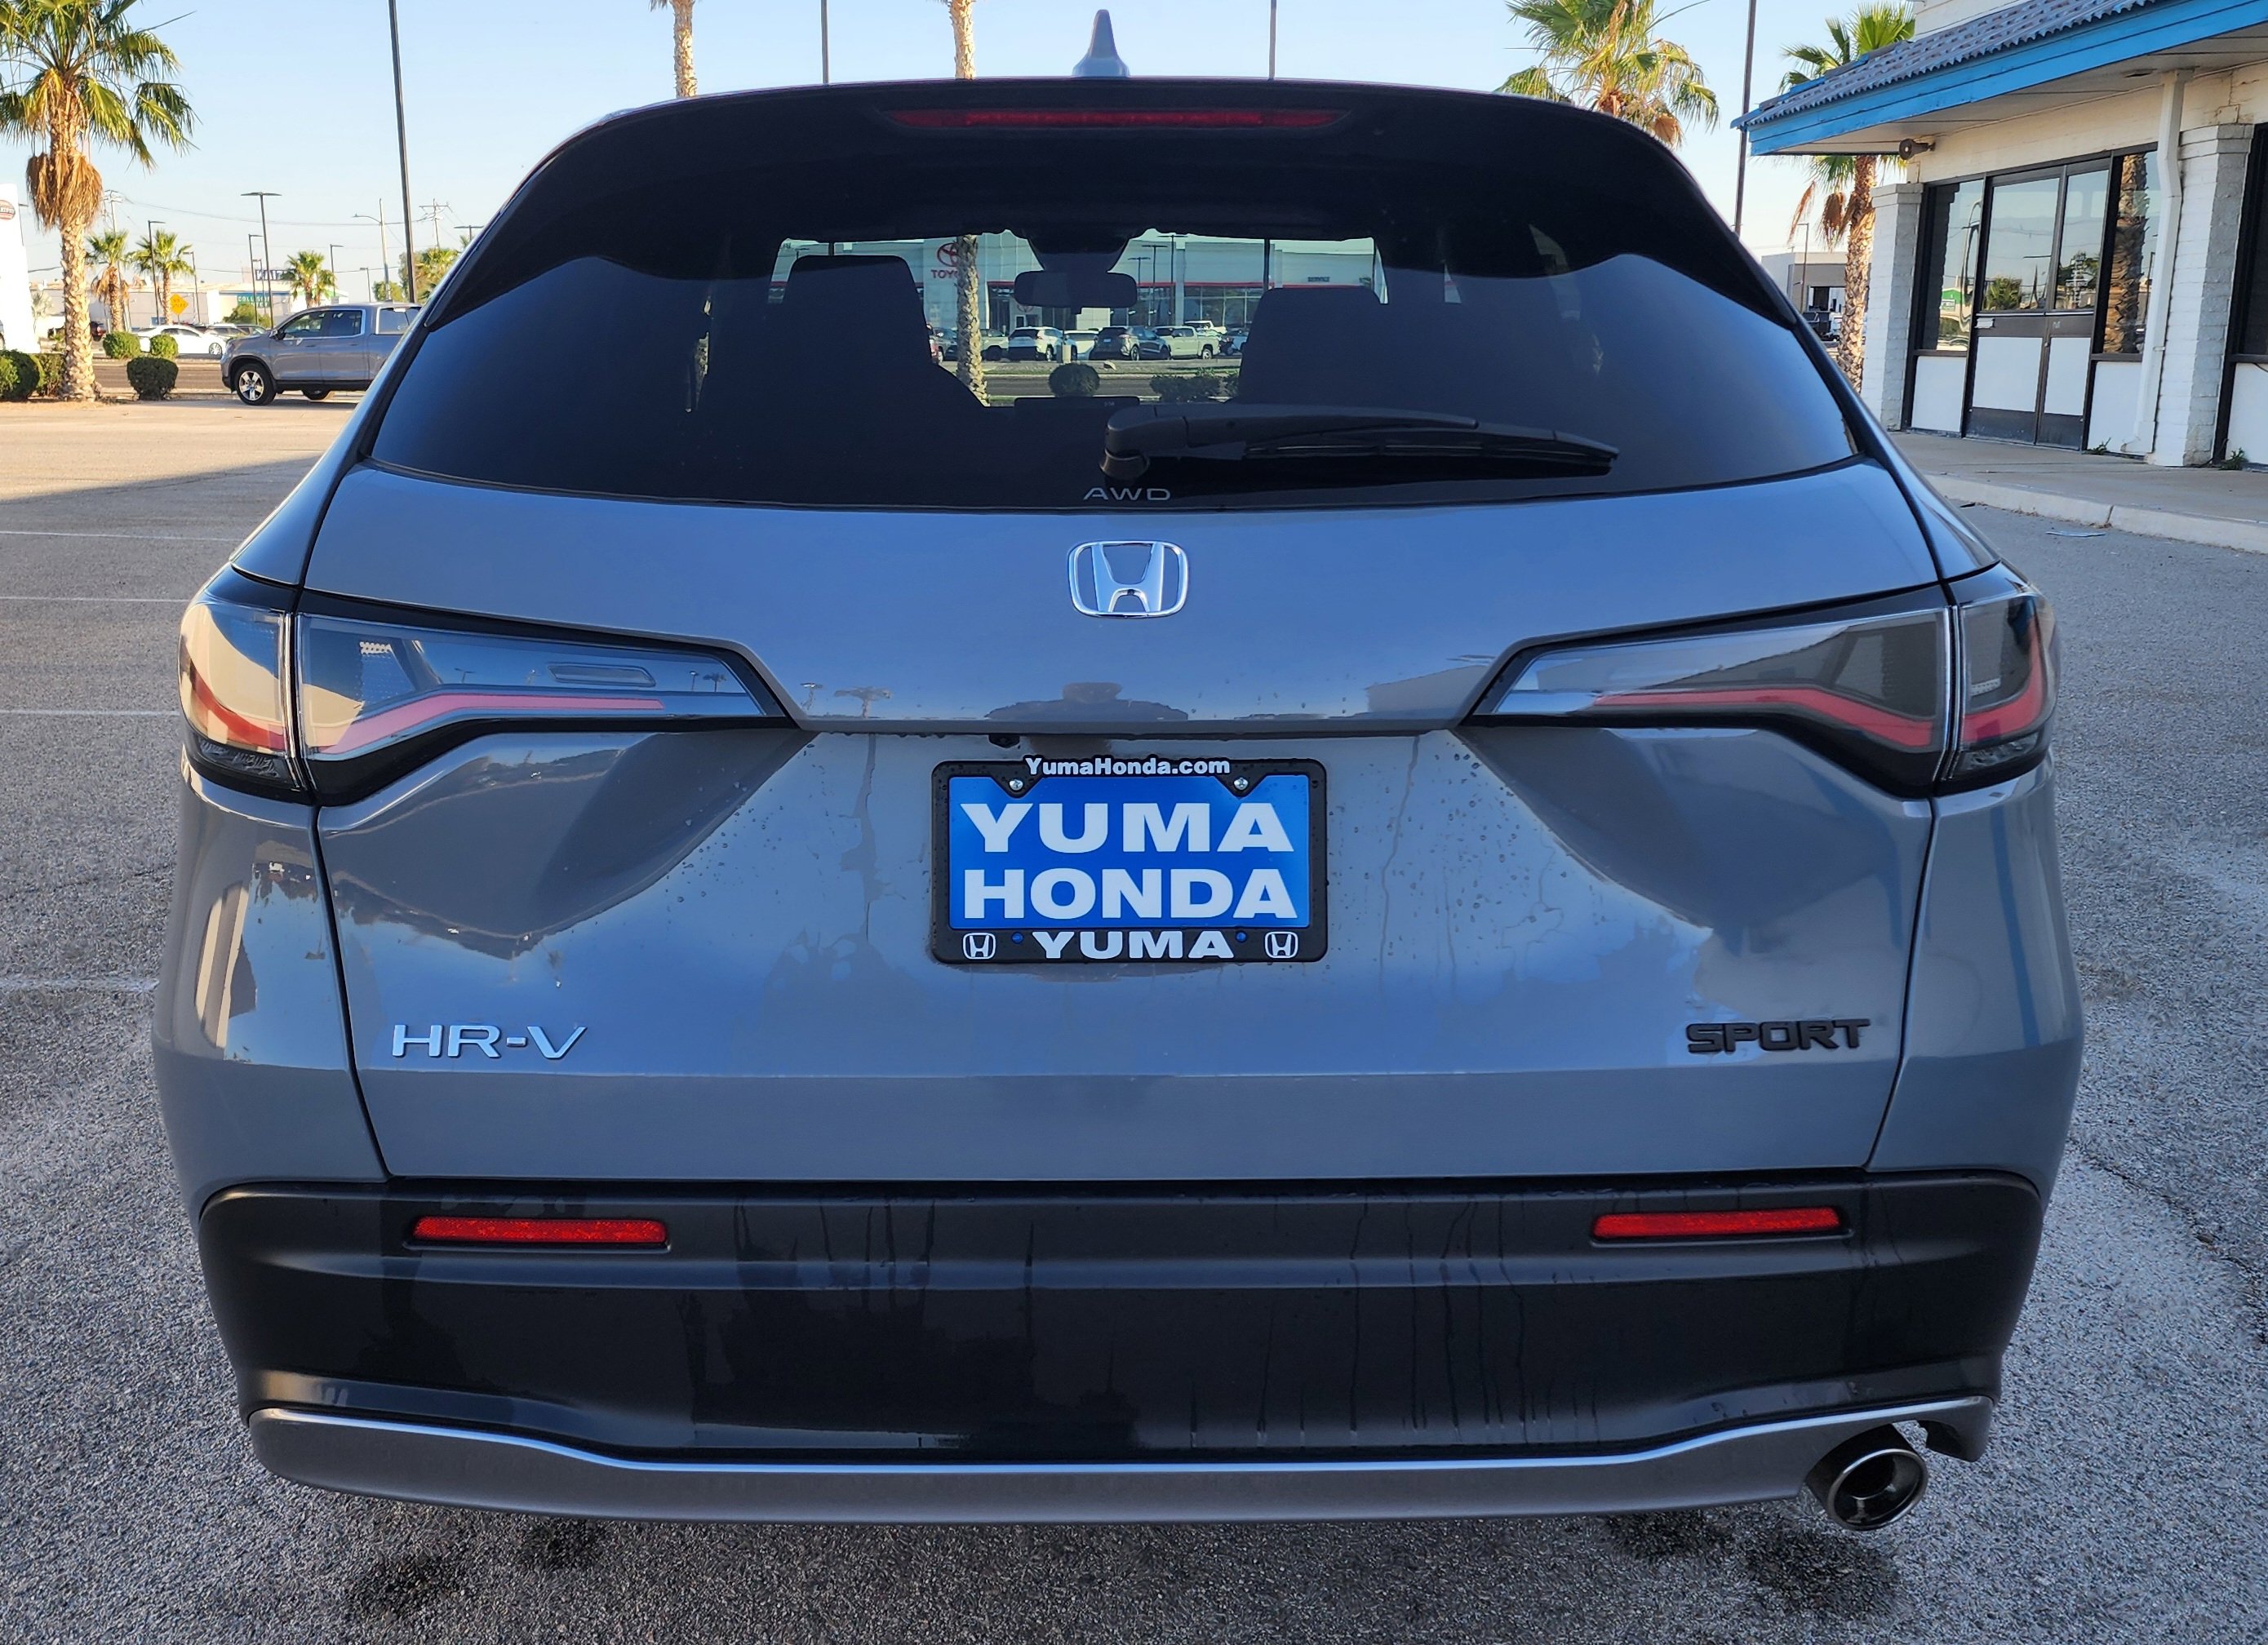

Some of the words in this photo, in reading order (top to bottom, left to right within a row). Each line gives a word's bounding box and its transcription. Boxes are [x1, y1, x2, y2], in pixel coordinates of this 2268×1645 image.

[1083, 487, 1171, 501] AWD
[1025, 757, 1231, 776] YumaHonda.com
[960, 802, 1294, 854] YUMA
[963, 867, 1298, 920] HONDA
[1032, 930, 1235, 960] YUMA
[393, 1024, 588, 1059] HR-V
[1686, 1018, 1871, 1054] SPORT
